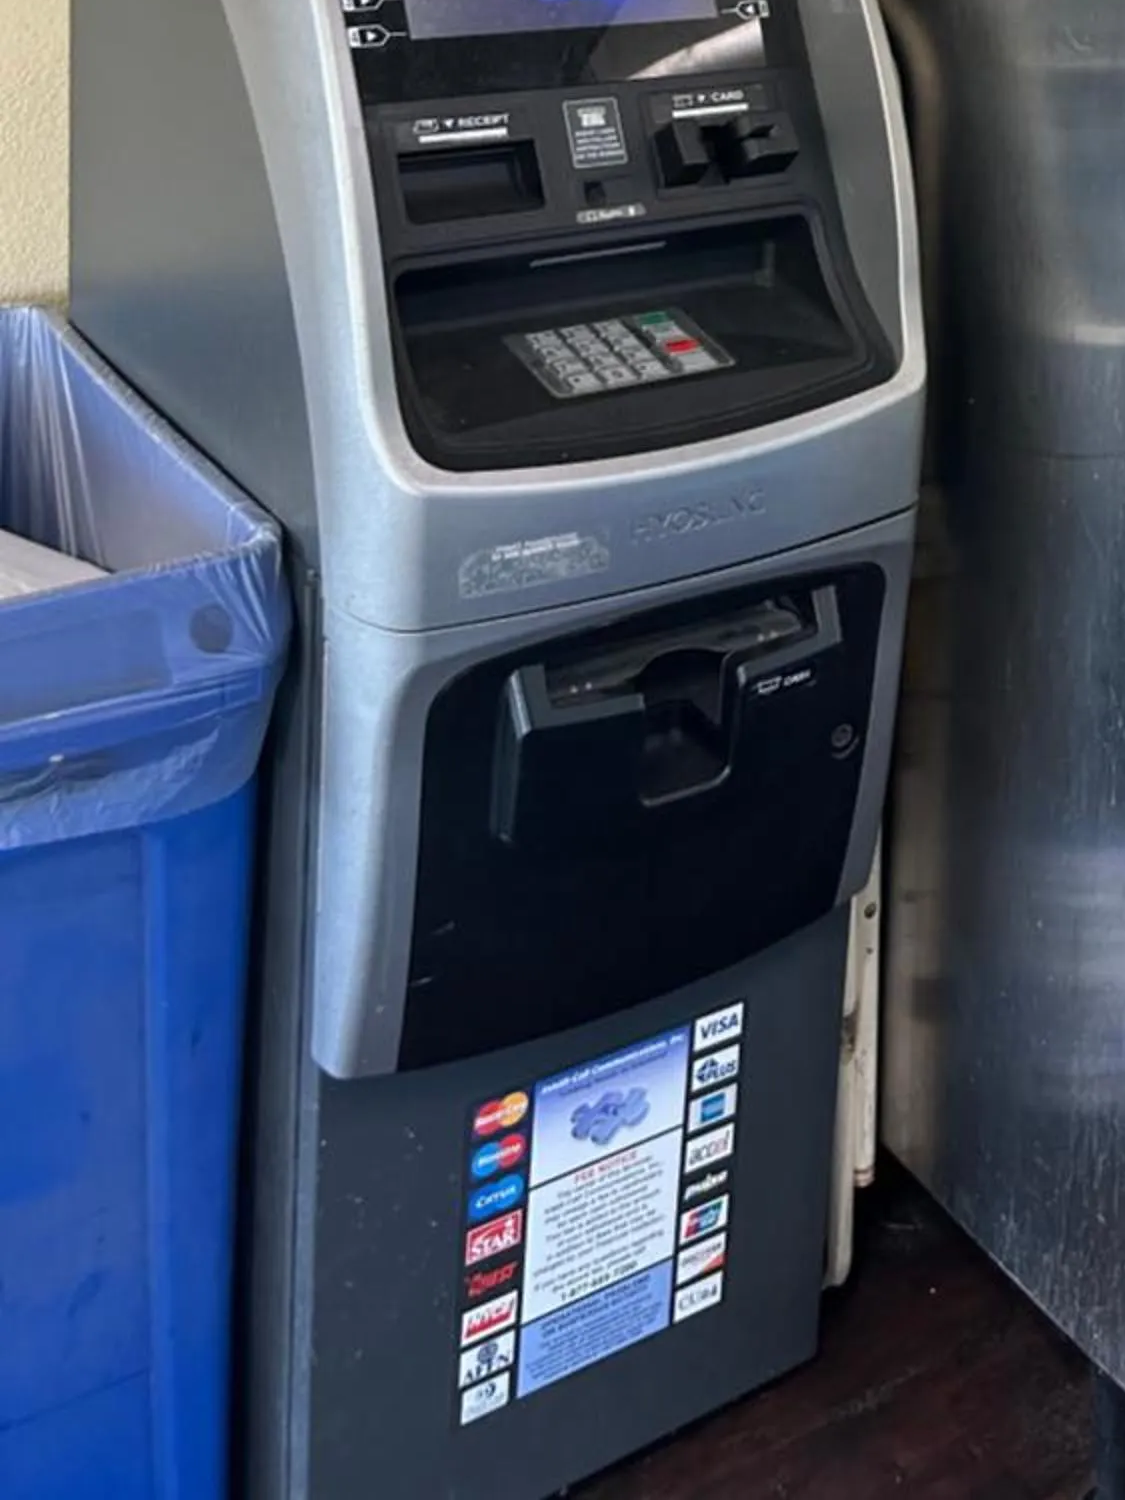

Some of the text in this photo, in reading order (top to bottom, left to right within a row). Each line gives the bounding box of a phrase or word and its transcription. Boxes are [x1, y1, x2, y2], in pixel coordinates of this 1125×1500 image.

[711, 90, 744, 103] CARD
[457, 113, 510, 129] RECEIPT
[701, 1012, 739, 1039] VISA
[471, 1228, 516, 1260] STAR
